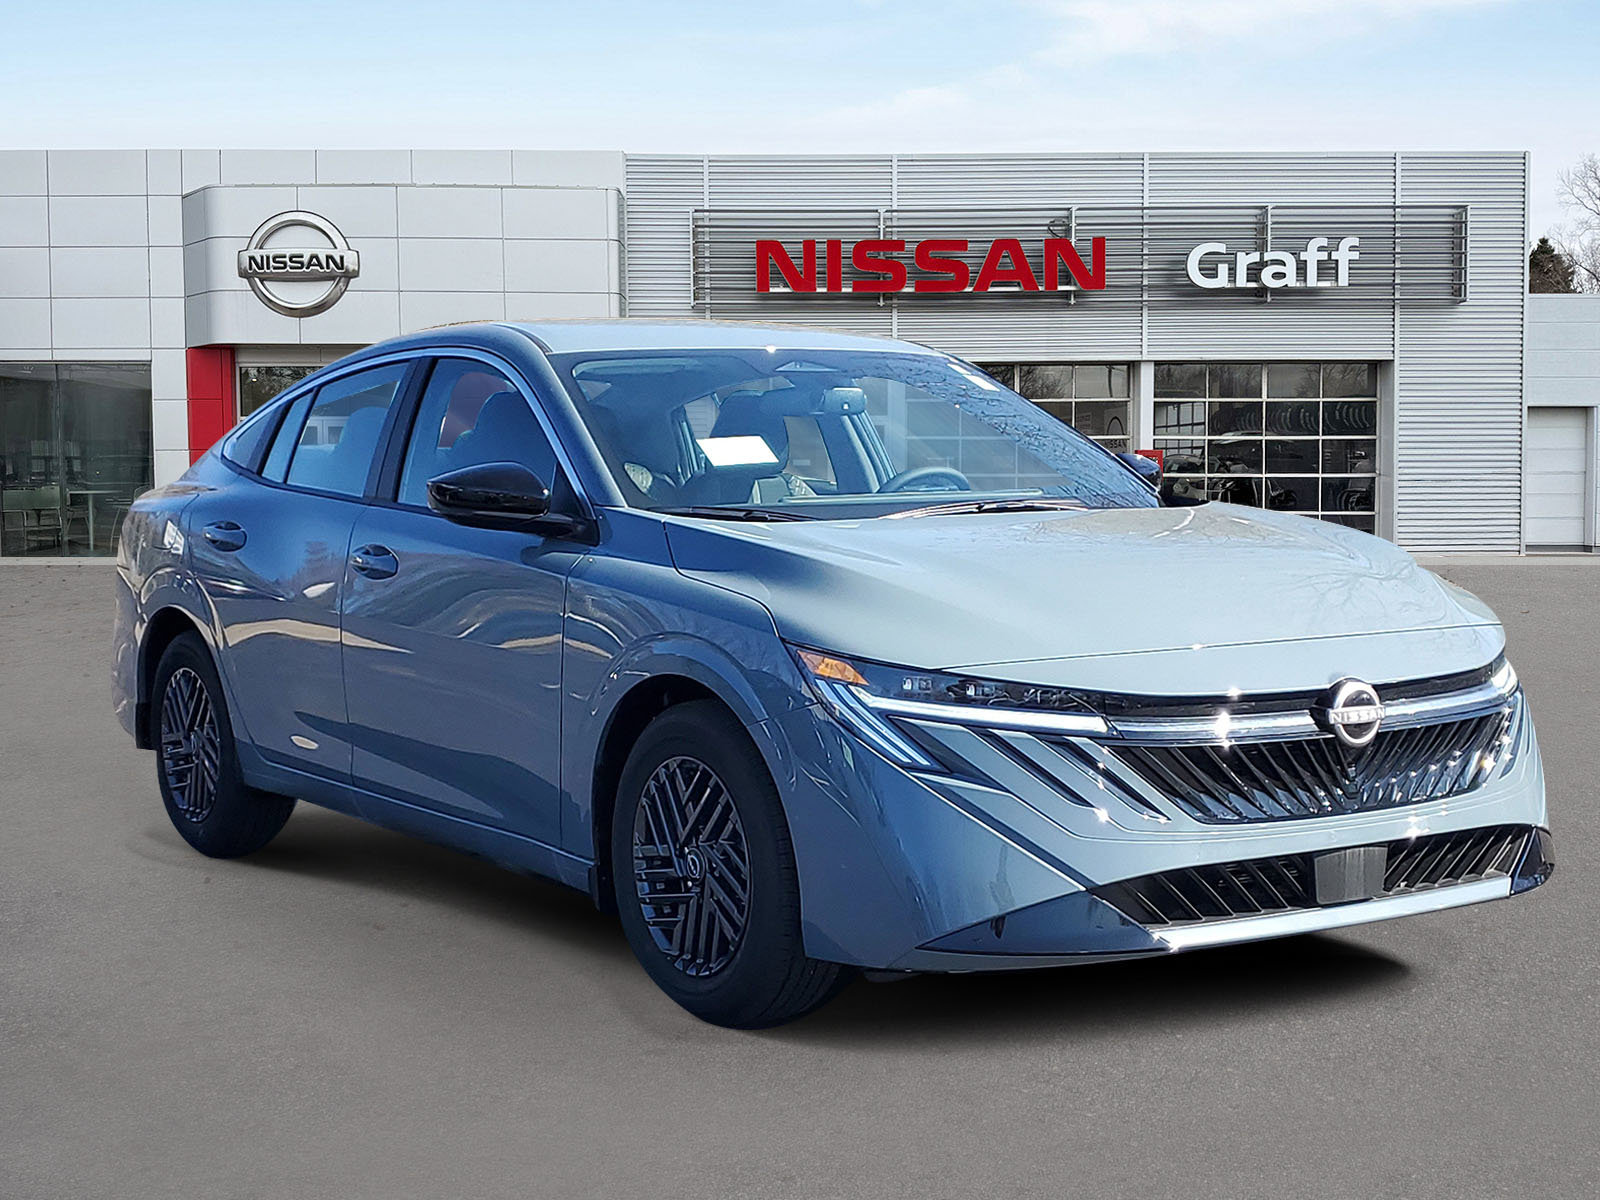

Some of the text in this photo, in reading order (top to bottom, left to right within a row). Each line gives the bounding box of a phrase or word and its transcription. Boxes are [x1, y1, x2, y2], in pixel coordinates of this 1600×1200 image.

[248, 254, 345, 271] NISSAN
[755, 237, 1106, 292] NISSAN
[1187, 237, 1360, 288] Graff
[1329, 706, 1385, 724] NISSAN
